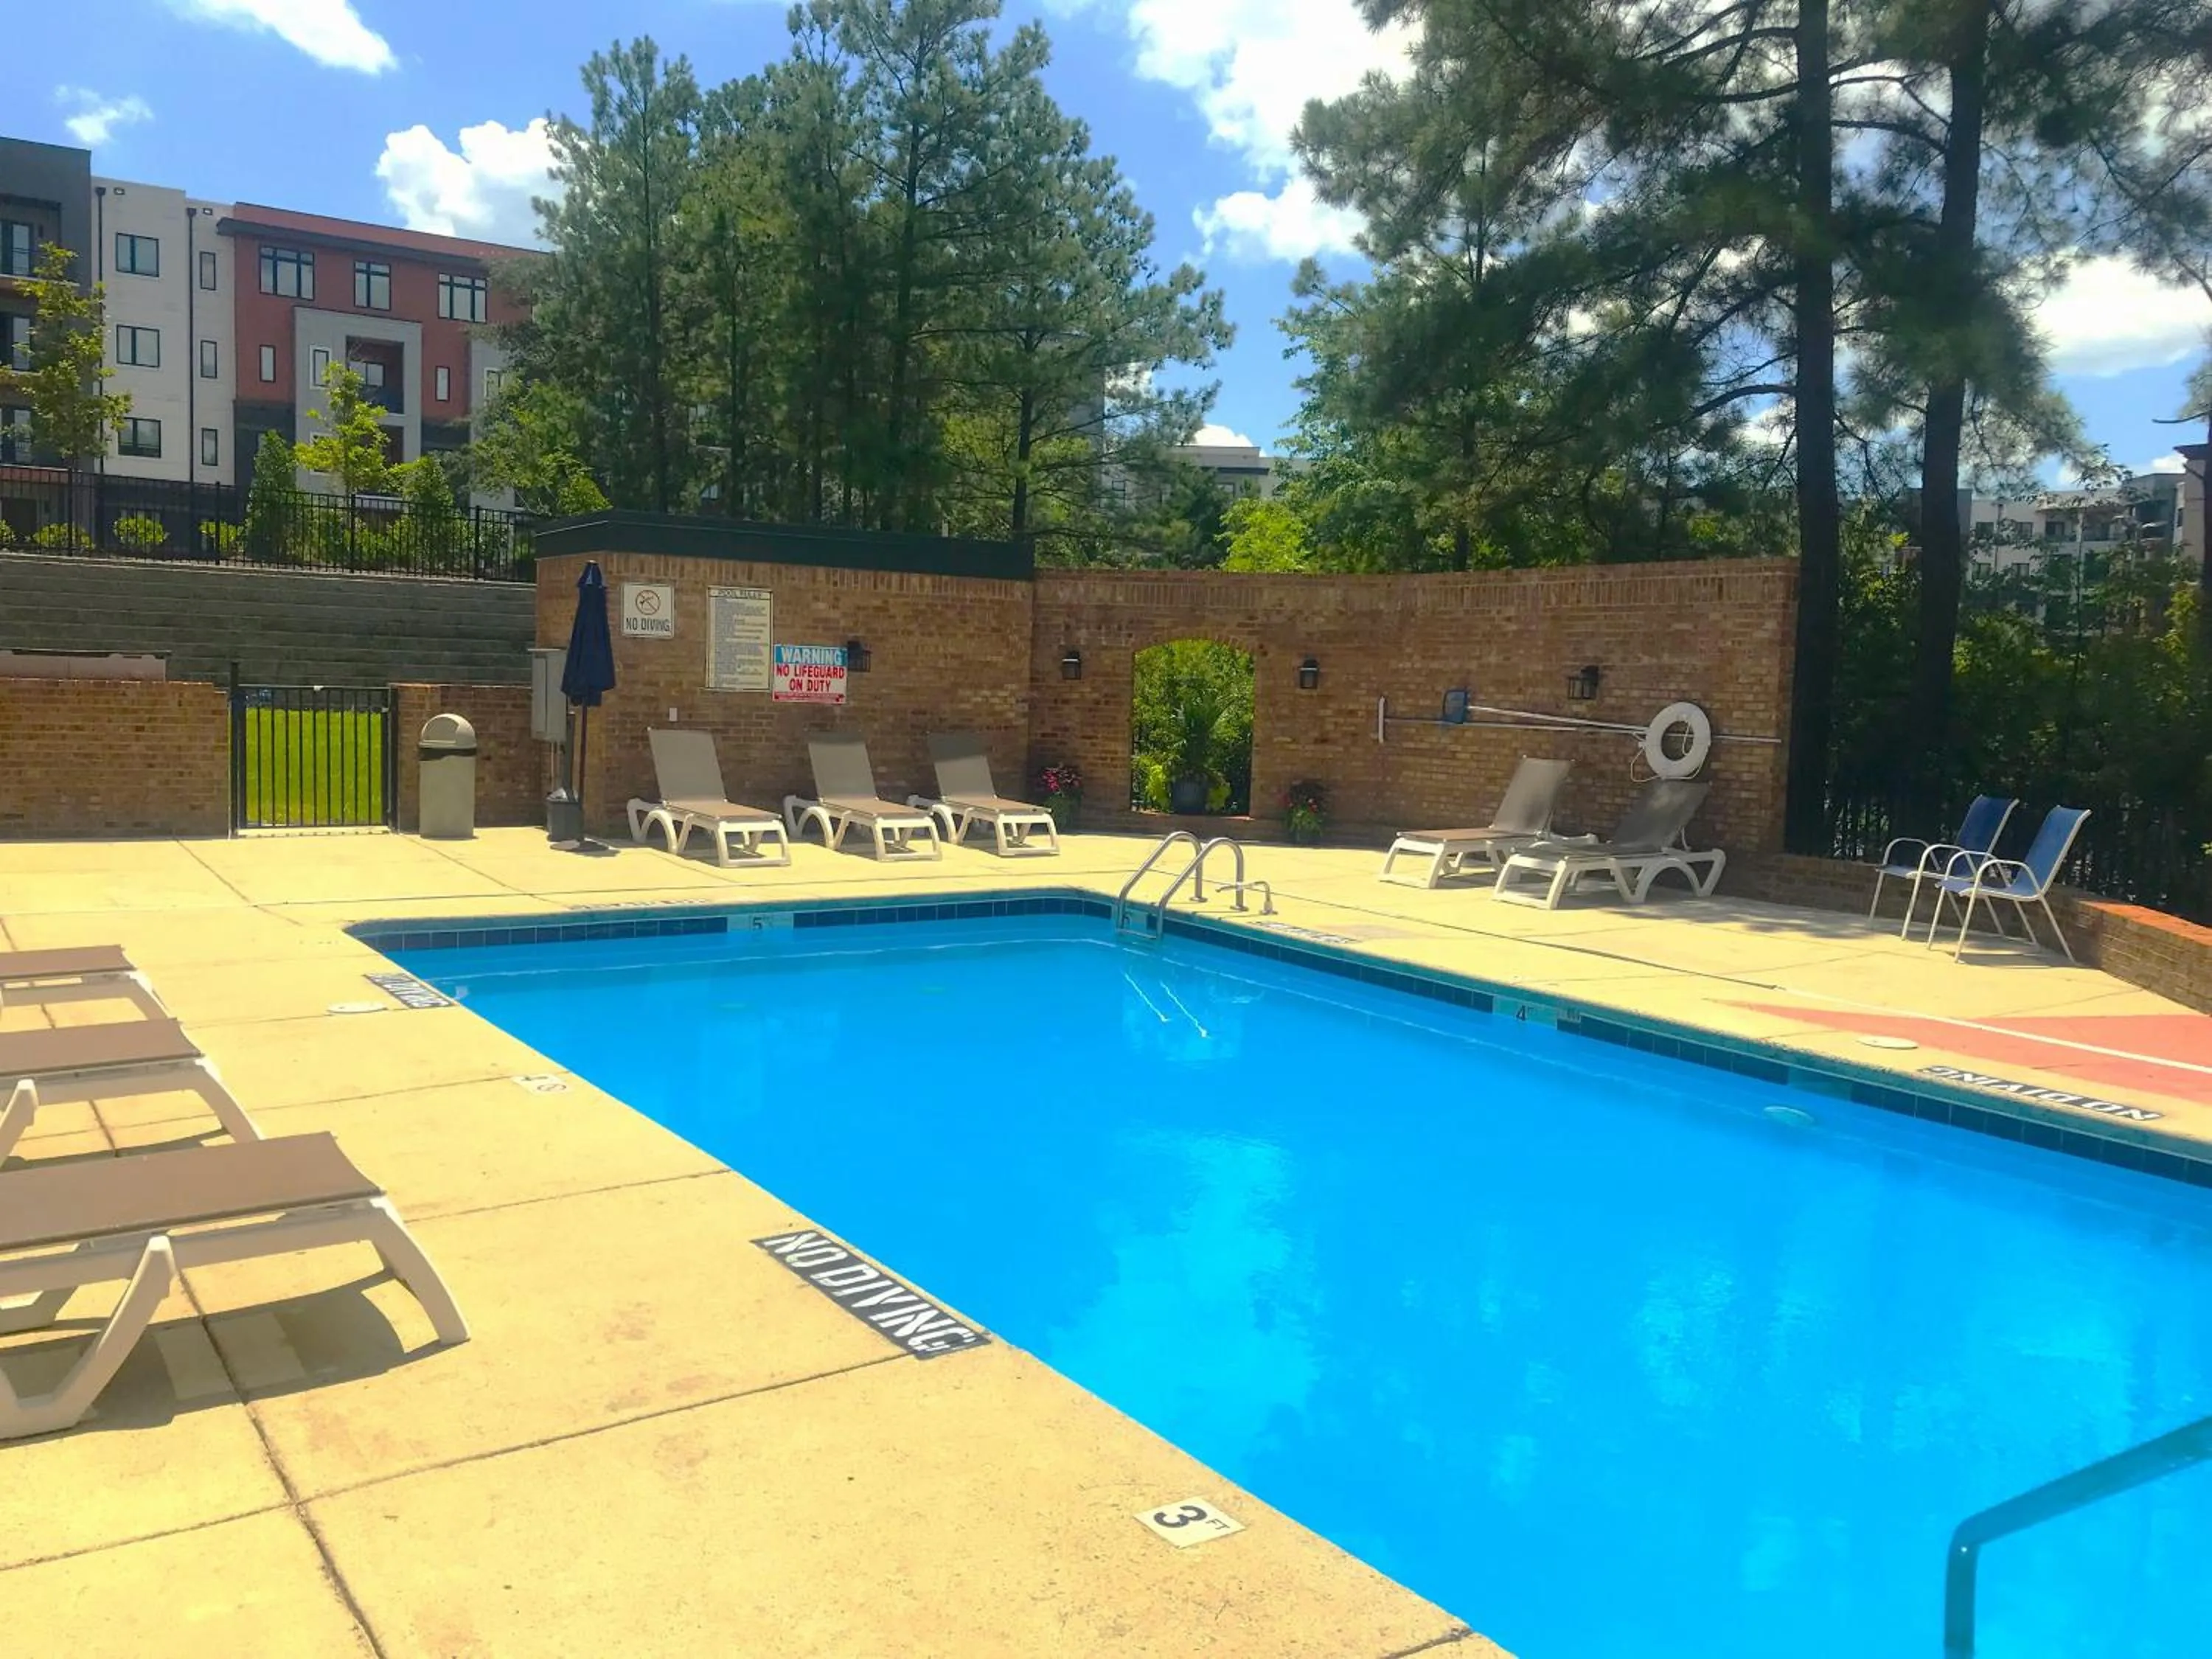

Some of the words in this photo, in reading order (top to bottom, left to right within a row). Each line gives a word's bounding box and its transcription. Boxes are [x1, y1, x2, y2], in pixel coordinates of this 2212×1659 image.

[626, 618, 638, 630] NO
[641, 618, 670, 632] DIVING
[781, 647, 844, 666] WARNING
[776, 664, 790, 677] NO
[794, 665, 844, 678] LIFEGUARD
[790, 678, 803, 691] ON
[807, 679, 830, 692] DUTY
[1516, 1005, 1526, 1021] 4
[762, 1231, 848, 1268] NO
[810, 1262, 978, 1353] DIVING
[1153, 1506, 1208, 1528] 3
[1205, 1518, 1231, 1530] FT
